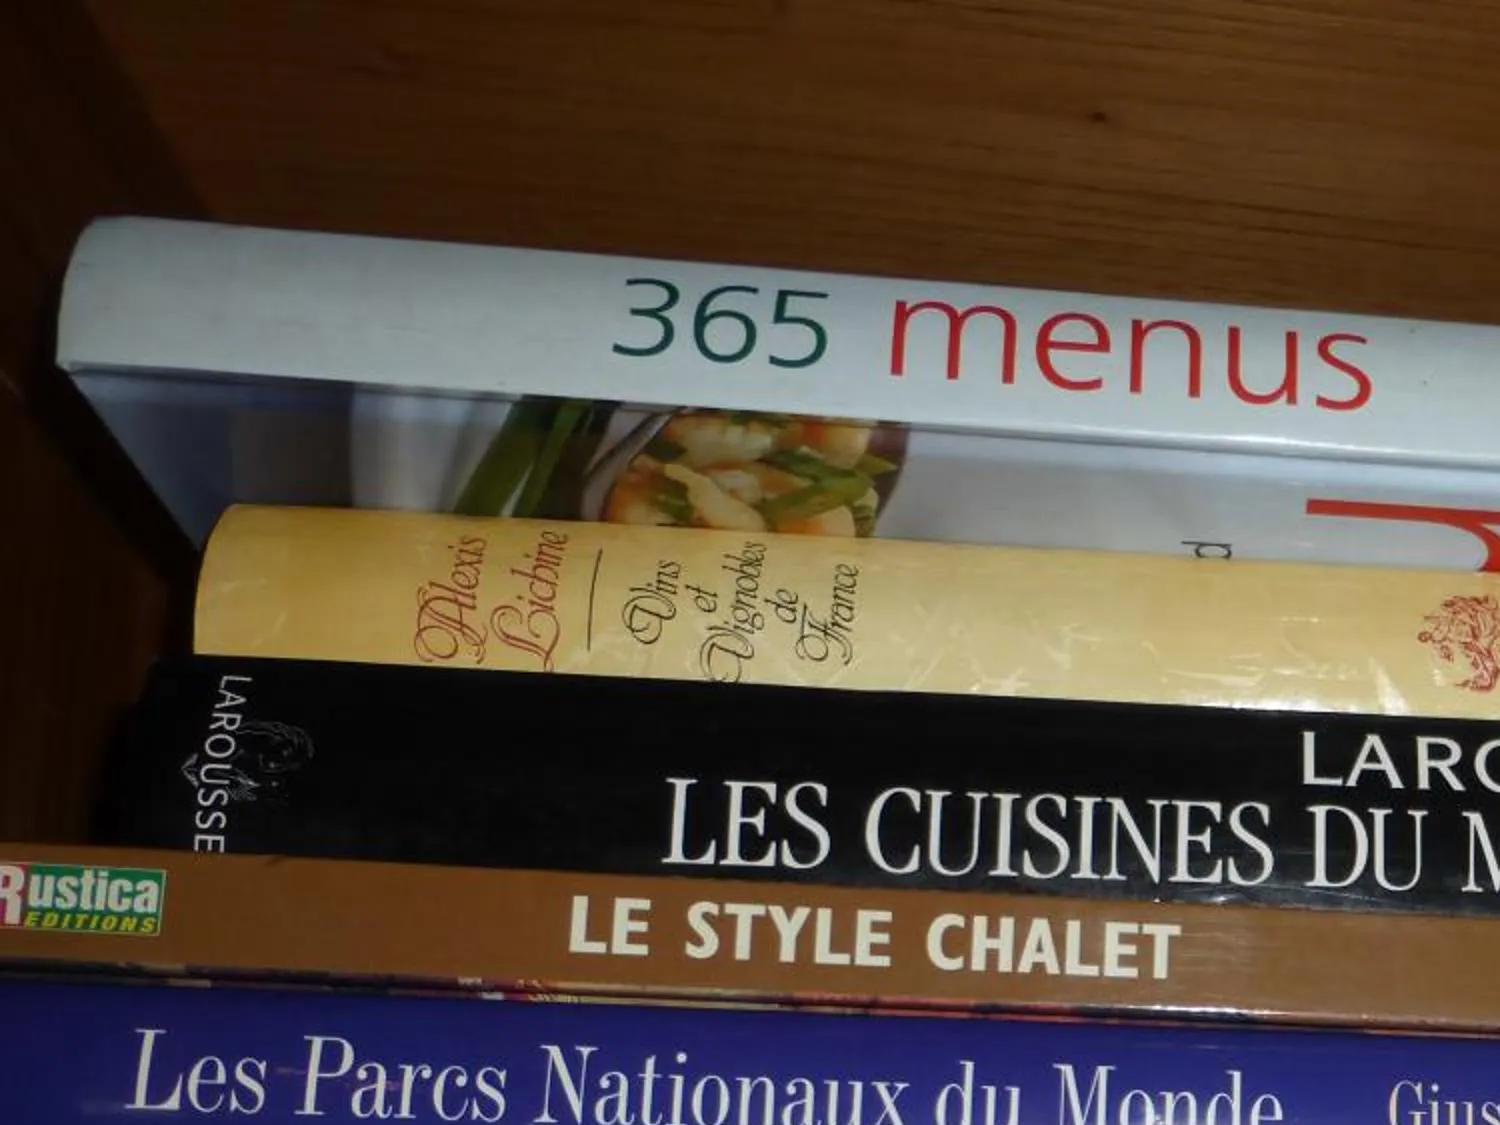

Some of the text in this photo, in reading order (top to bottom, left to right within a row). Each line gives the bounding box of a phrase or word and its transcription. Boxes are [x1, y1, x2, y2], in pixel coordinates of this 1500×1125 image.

[611, 277, 1374, 411] 365 menus
[414, 534, 487, 664] Alexis
[490, 530, 569, 672] Lichine
[621, 559, 682, 645] Vins
[684, 584, 718, 614] et
[700, 541, 767, 684] Vignobles
[764, 588, 800, 624] de
[795, 562, 859, 667] France
[193, 674, 252, 854] LAROUSSE
[661, 777, 833, 870] LES
[863, 787, 1277, 888] CUISINES
[1307, 804, 1425, 894] DU
[0, 864, 160, 925] Rustica
[24, 911, 157, 934] EDITIONS
[568, 896, 1182, 982] LE STYLE CHALET
[124, 1028, 268, 1116] Les
[293, 1034, 509, 1124] Parcs
